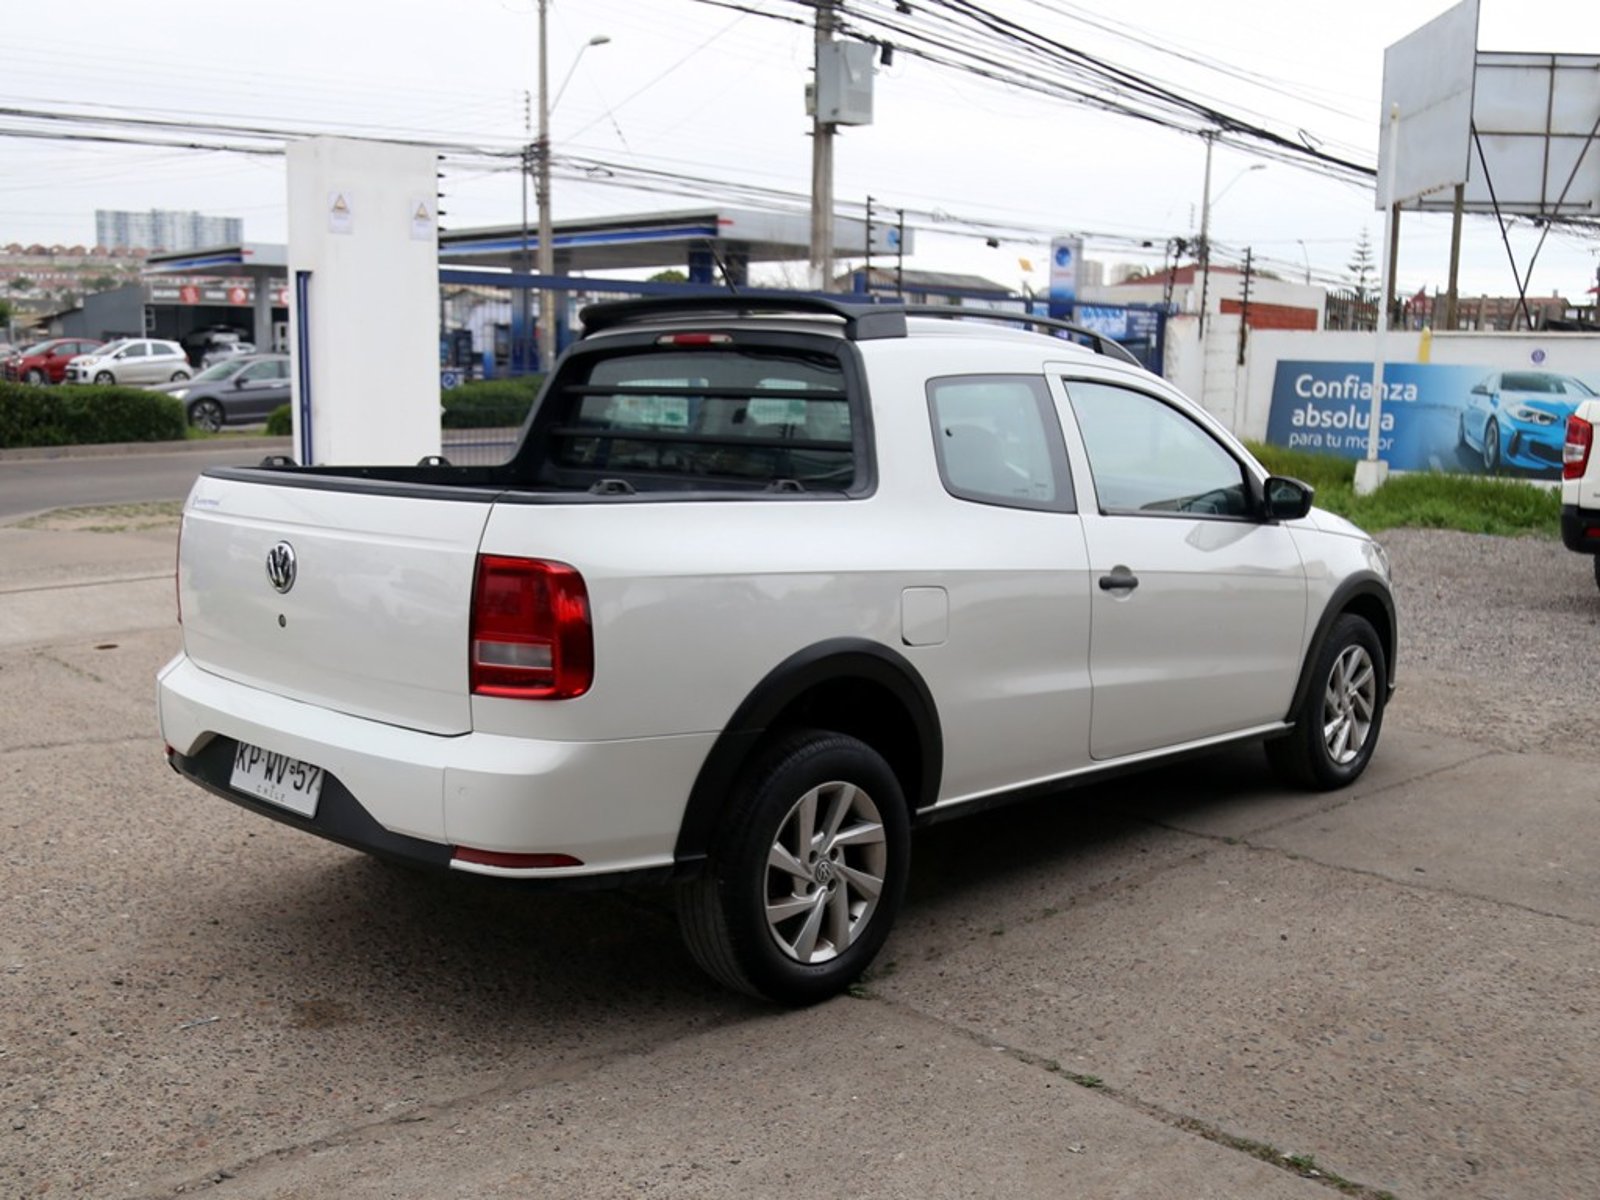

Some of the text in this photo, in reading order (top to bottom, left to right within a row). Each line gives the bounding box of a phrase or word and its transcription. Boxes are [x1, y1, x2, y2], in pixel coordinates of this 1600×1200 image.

[1295, 374, 1418, 401] Confianza
[1292, 403, 1395, 430] absolua
[1289, 432, 1394, 450] para tu moor
